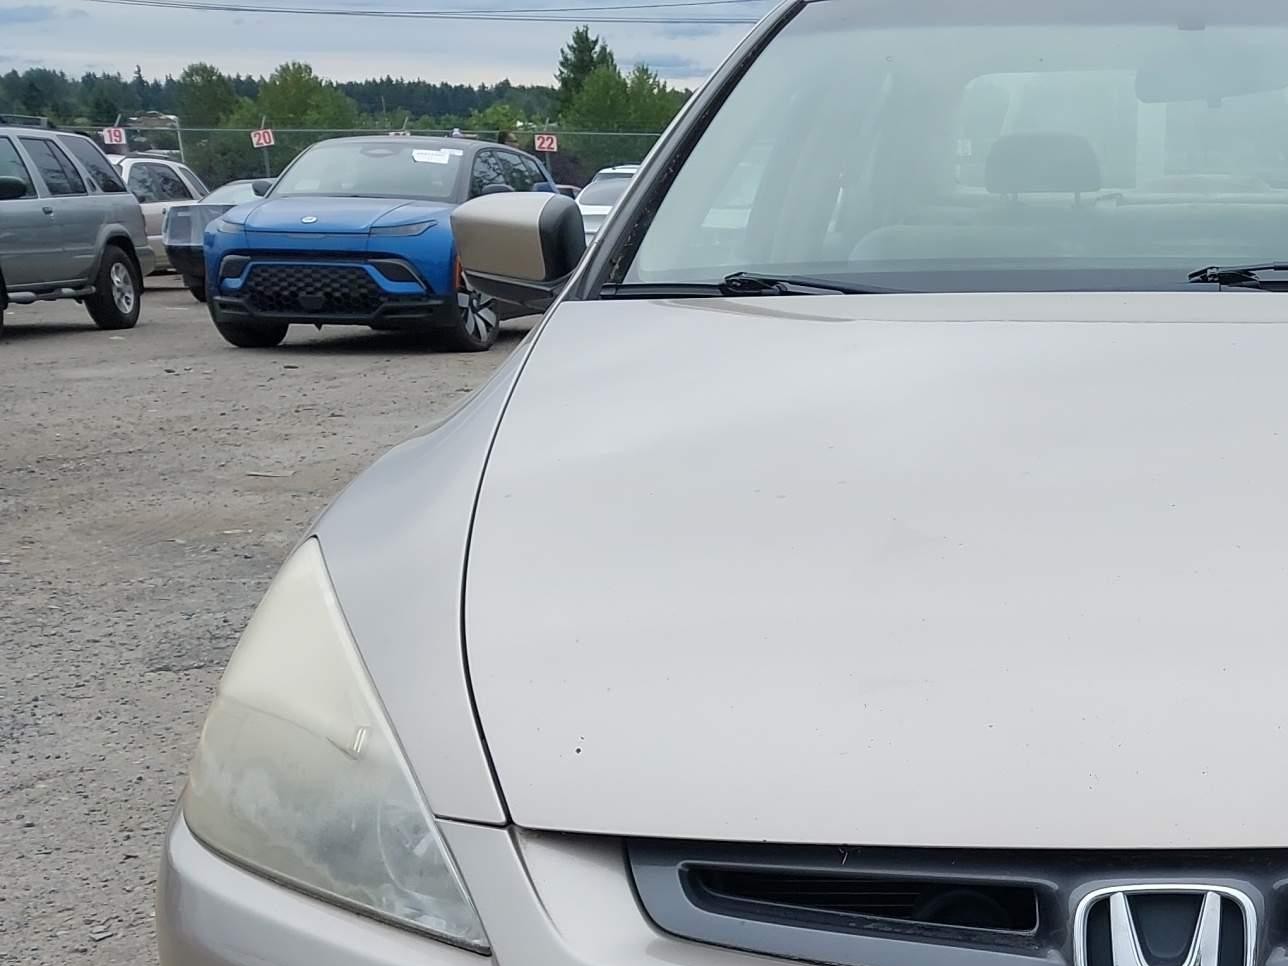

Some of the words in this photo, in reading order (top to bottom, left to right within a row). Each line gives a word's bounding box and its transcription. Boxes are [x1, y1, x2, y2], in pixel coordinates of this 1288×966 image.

[107, 129, 122, 143] 19
[253, 130, 272, 146] 20
[536, 135, 555, 150] 22
